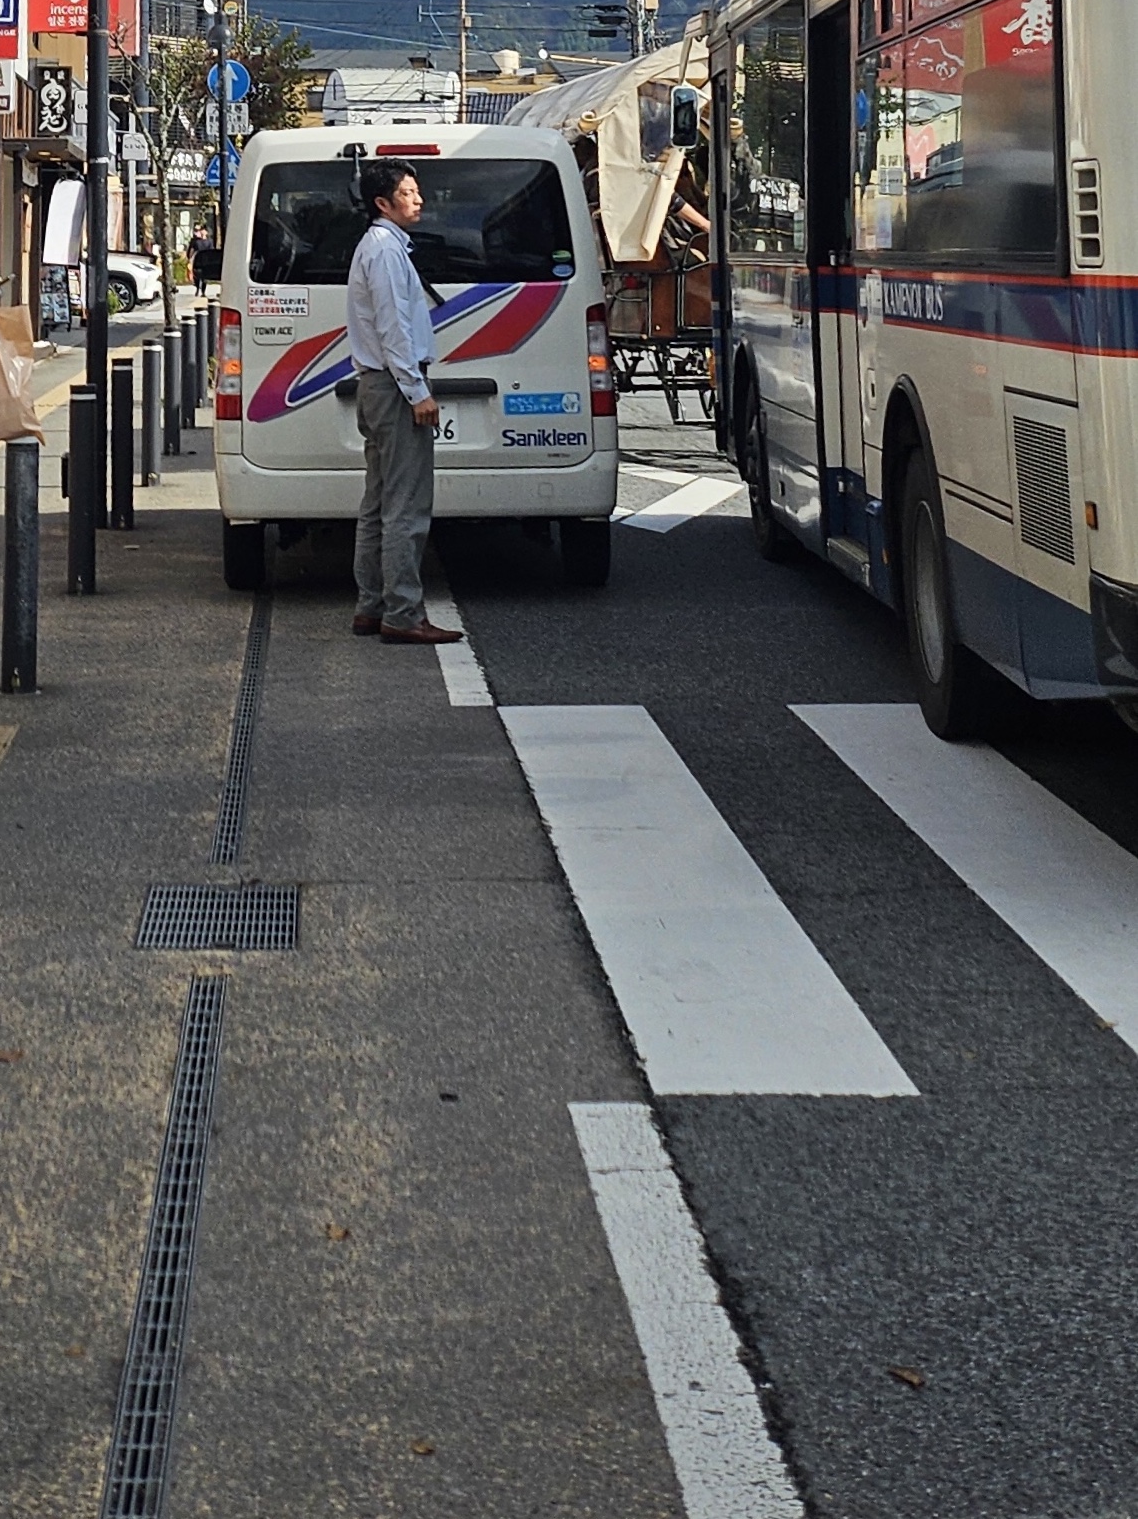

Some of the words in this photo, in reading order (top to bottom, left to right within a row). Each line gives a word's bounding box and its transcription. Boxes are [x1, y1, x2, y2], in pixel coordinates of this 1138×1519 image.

[50, 3, 88, 15] incens
[883, 282, 923, 319] KAMENOI
[925, 284, 944, 321] BUS
[254, 326, 276, 336] TOWN
[277, 326, 293, 336] ACE
[502, 429, 588, 447] Sanikleen
